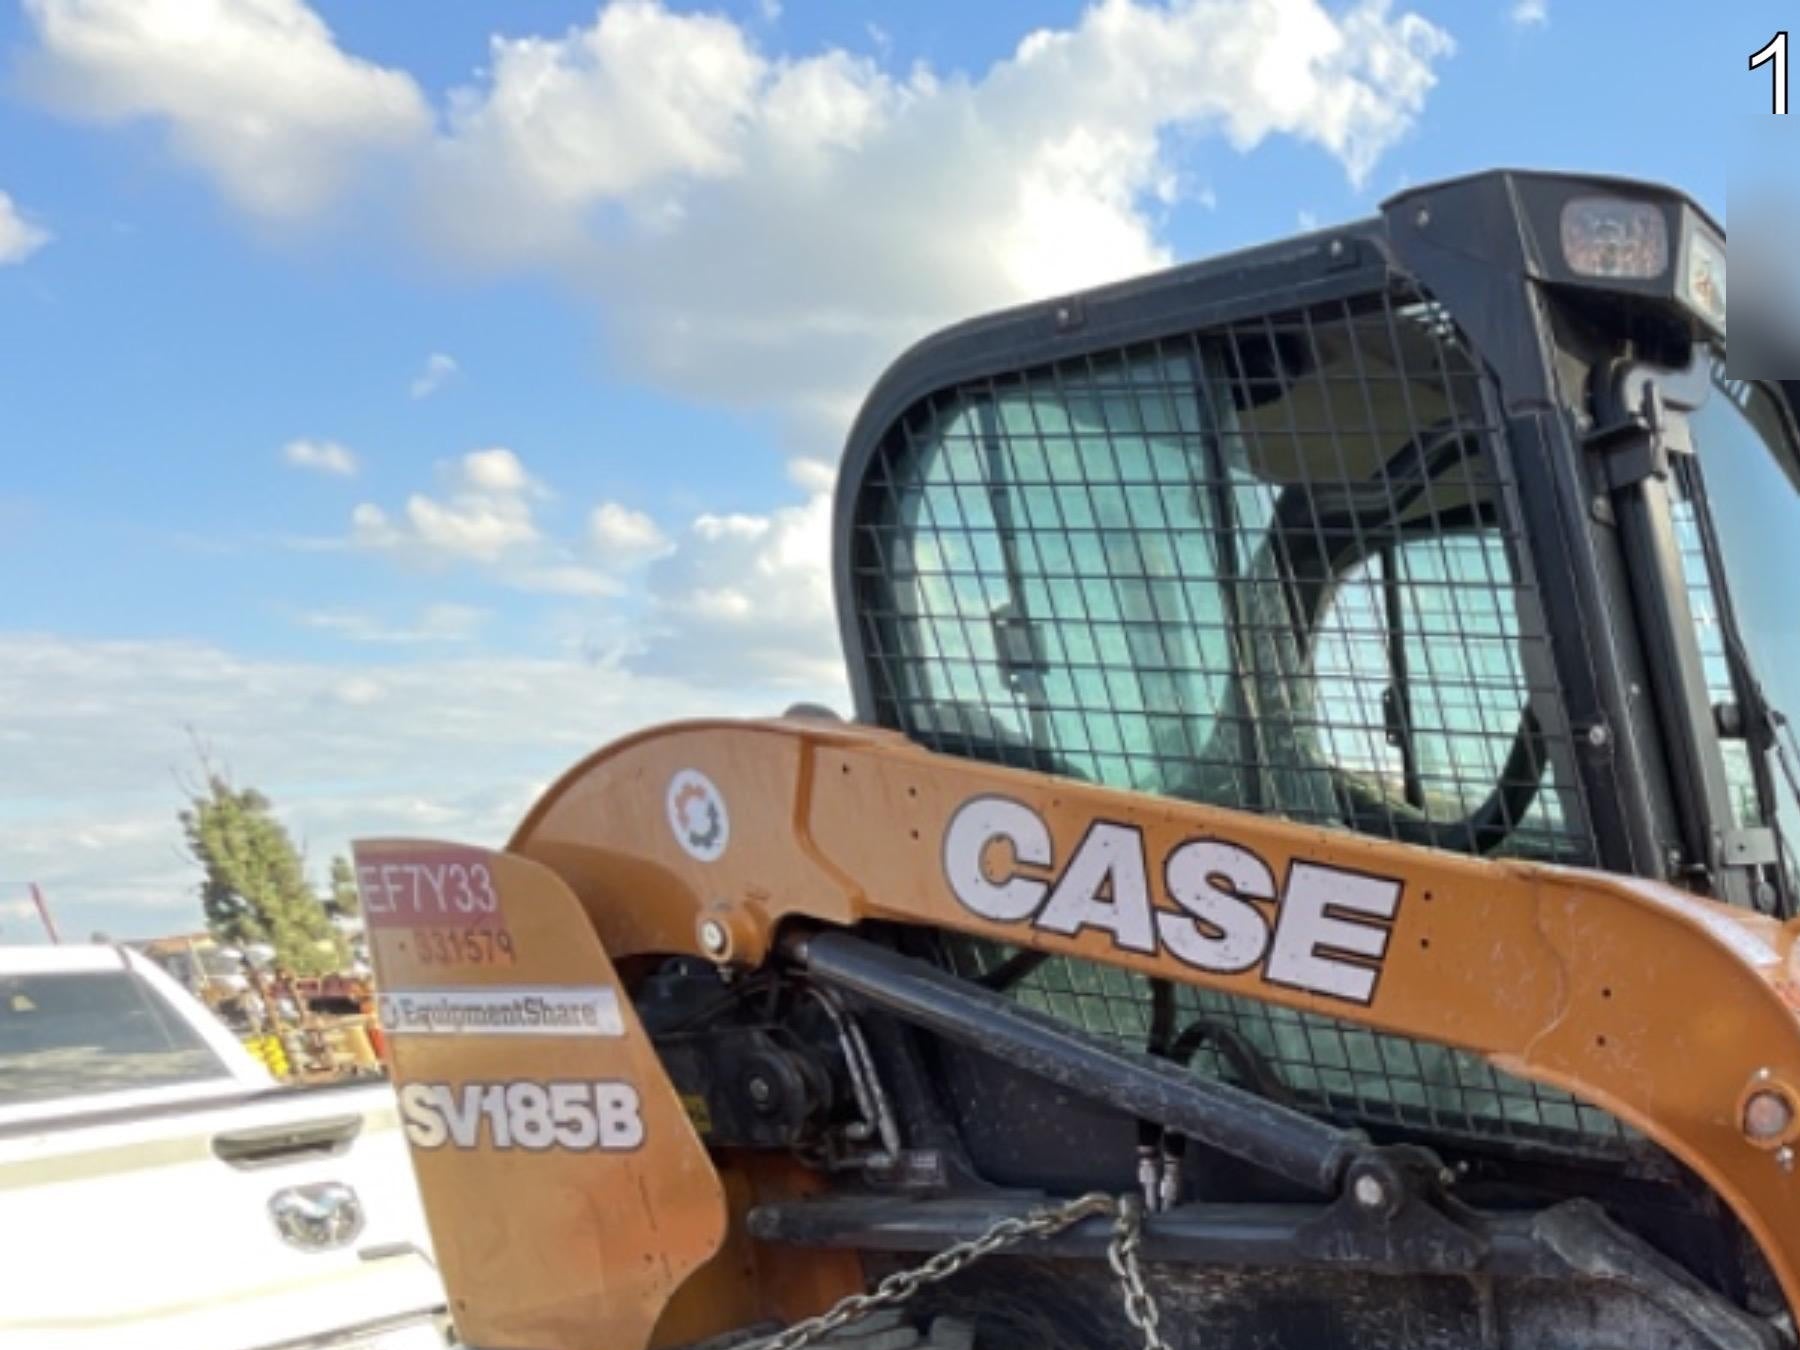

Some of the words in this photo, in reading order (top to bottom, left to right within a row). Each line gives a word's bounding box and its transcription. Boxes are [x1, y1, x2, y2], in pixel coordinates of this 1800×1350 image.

[941, 793, 1405, 1007] CASE
[399, 995, 599, 1032] EquipmentShare
[402, 1080, 646, 1151] SV185B
